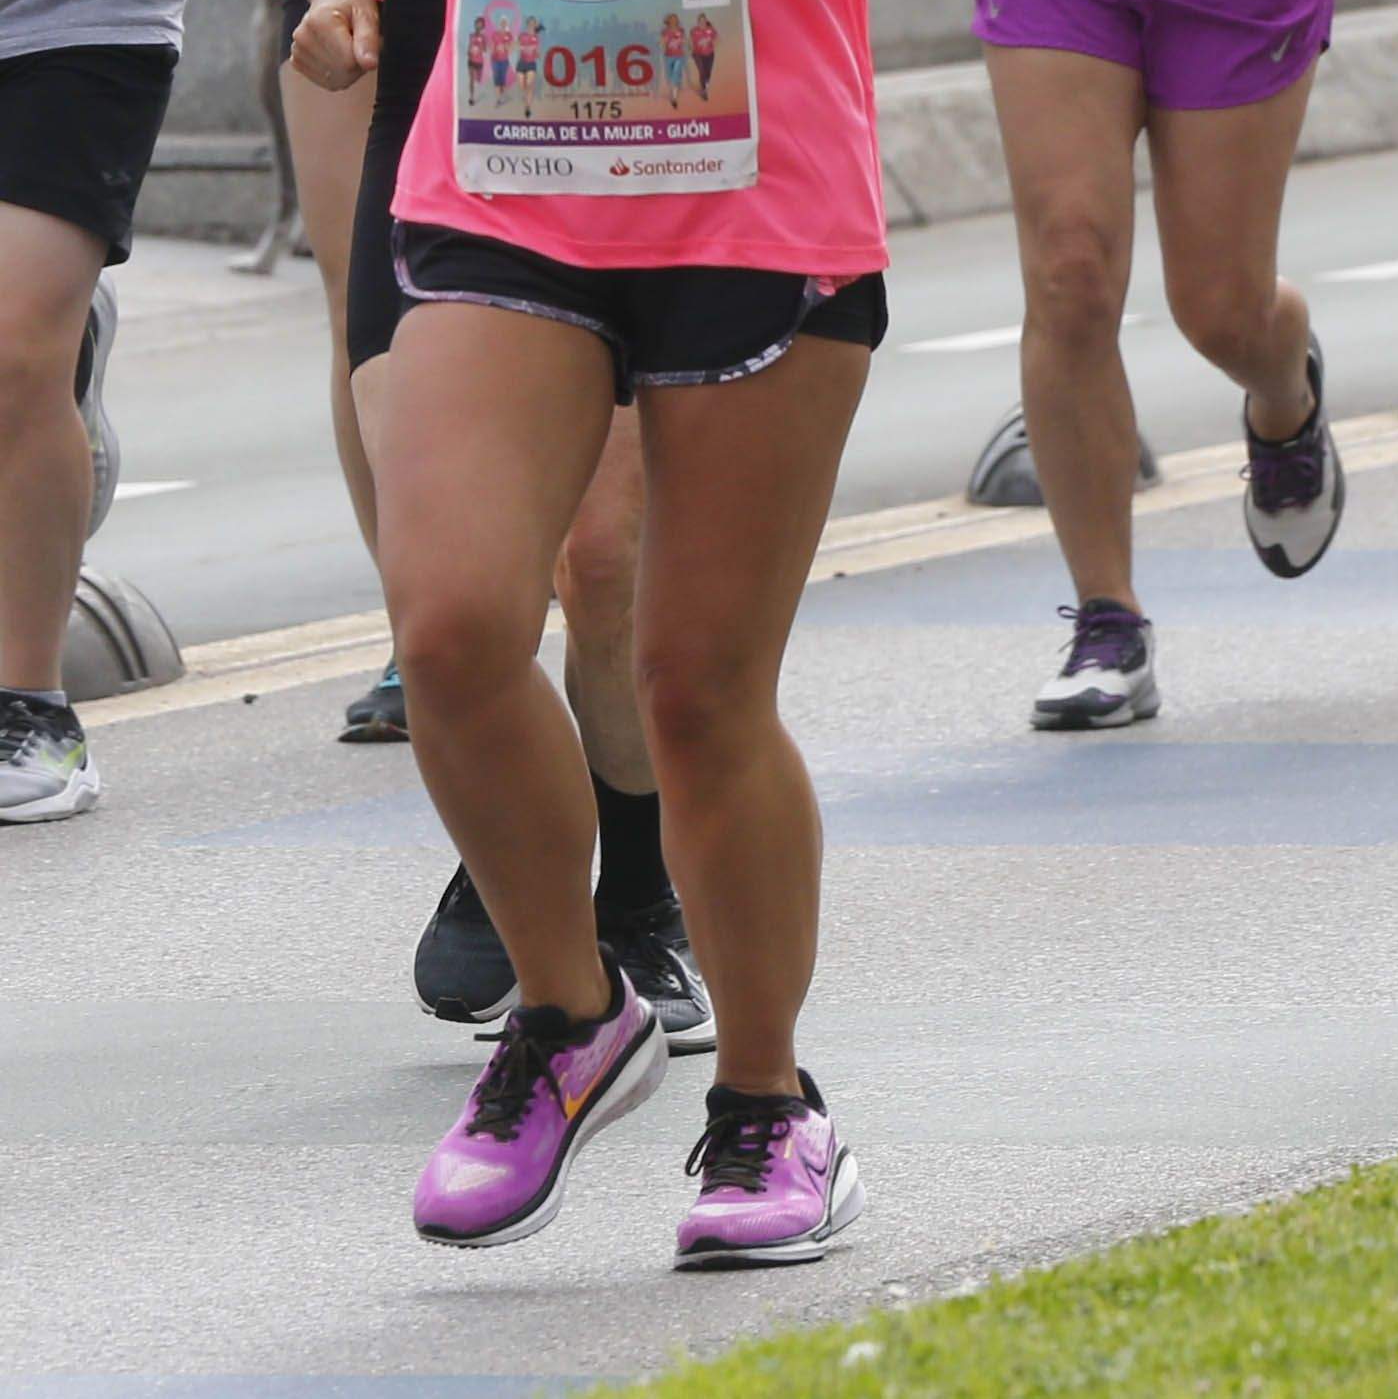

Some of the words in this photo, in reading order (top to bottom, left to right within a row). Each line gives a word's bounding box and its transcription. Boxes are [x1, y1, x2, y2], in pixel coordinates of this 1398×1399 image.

[543, 43, 655, 89] 016
[570, 100, 623, 120] 1175
[493, 124, 555, 141] CARRERA
[559, 125, 578, 142] DE
[581, 124, 600, 141] LA
[604, 124, 654, 141] MUJER
[667, 119, 710, 138] GIJÓN
[486, 154, 573, 177] OYSHO
[633, 157, 725, 177] Santander
